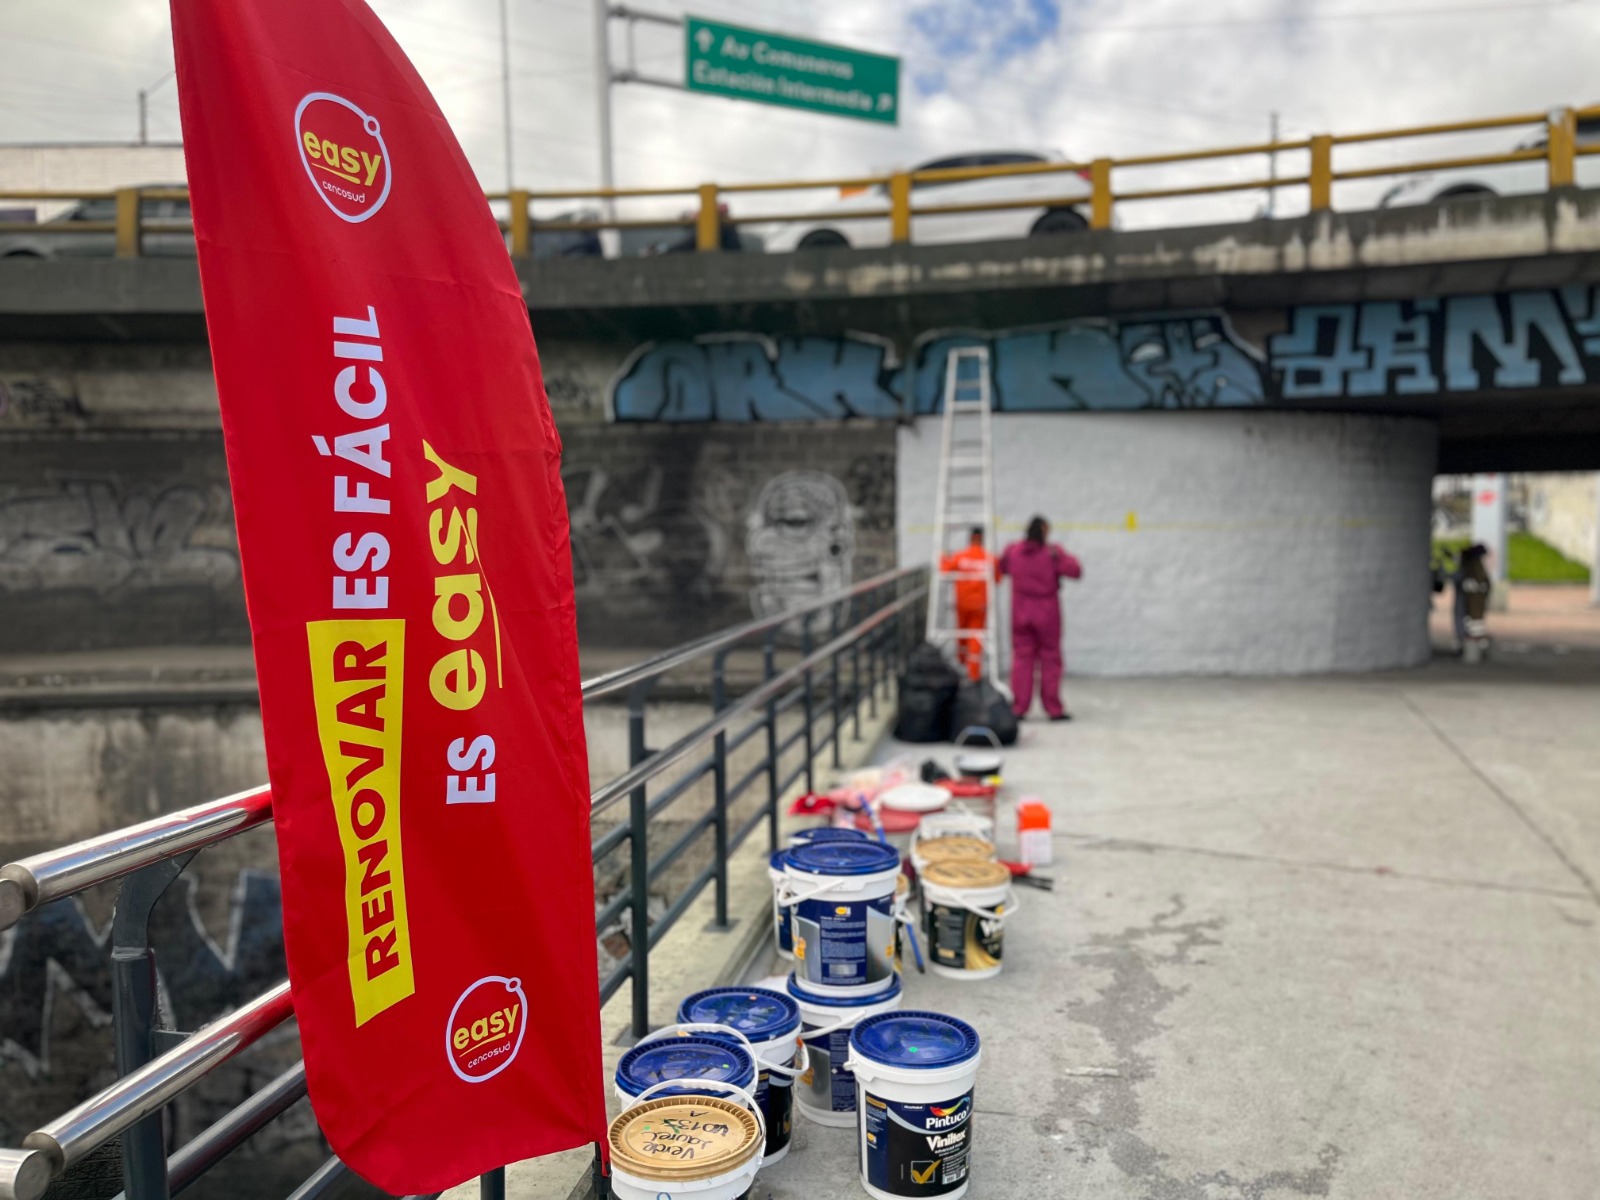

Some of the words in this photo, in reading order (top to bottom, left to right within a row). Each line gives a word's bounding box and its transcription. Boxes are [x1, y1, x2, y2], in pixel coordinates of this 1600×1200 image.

[752, 40, 855, 80] Comuneros
[777, 76, 873, 112] Intermedia
[303, 131, 382, 187] easy
[322, 180, 366, 203] cencosud
[311, 304, 392, 515] FÁCIL
[332, 531, 391, 609] ES
[422, 438, 486, 711] easy
[446, 733, 496, 805] ES
[332, 639, 401, 982] RENOVAR
[453, 1003, 520, 1050] easy
[467, 1041, 511, 1069] cencosud
[925, 1109, 967, 1129] Pintuco
[925, 1129, 966, 1152] Viniltex
